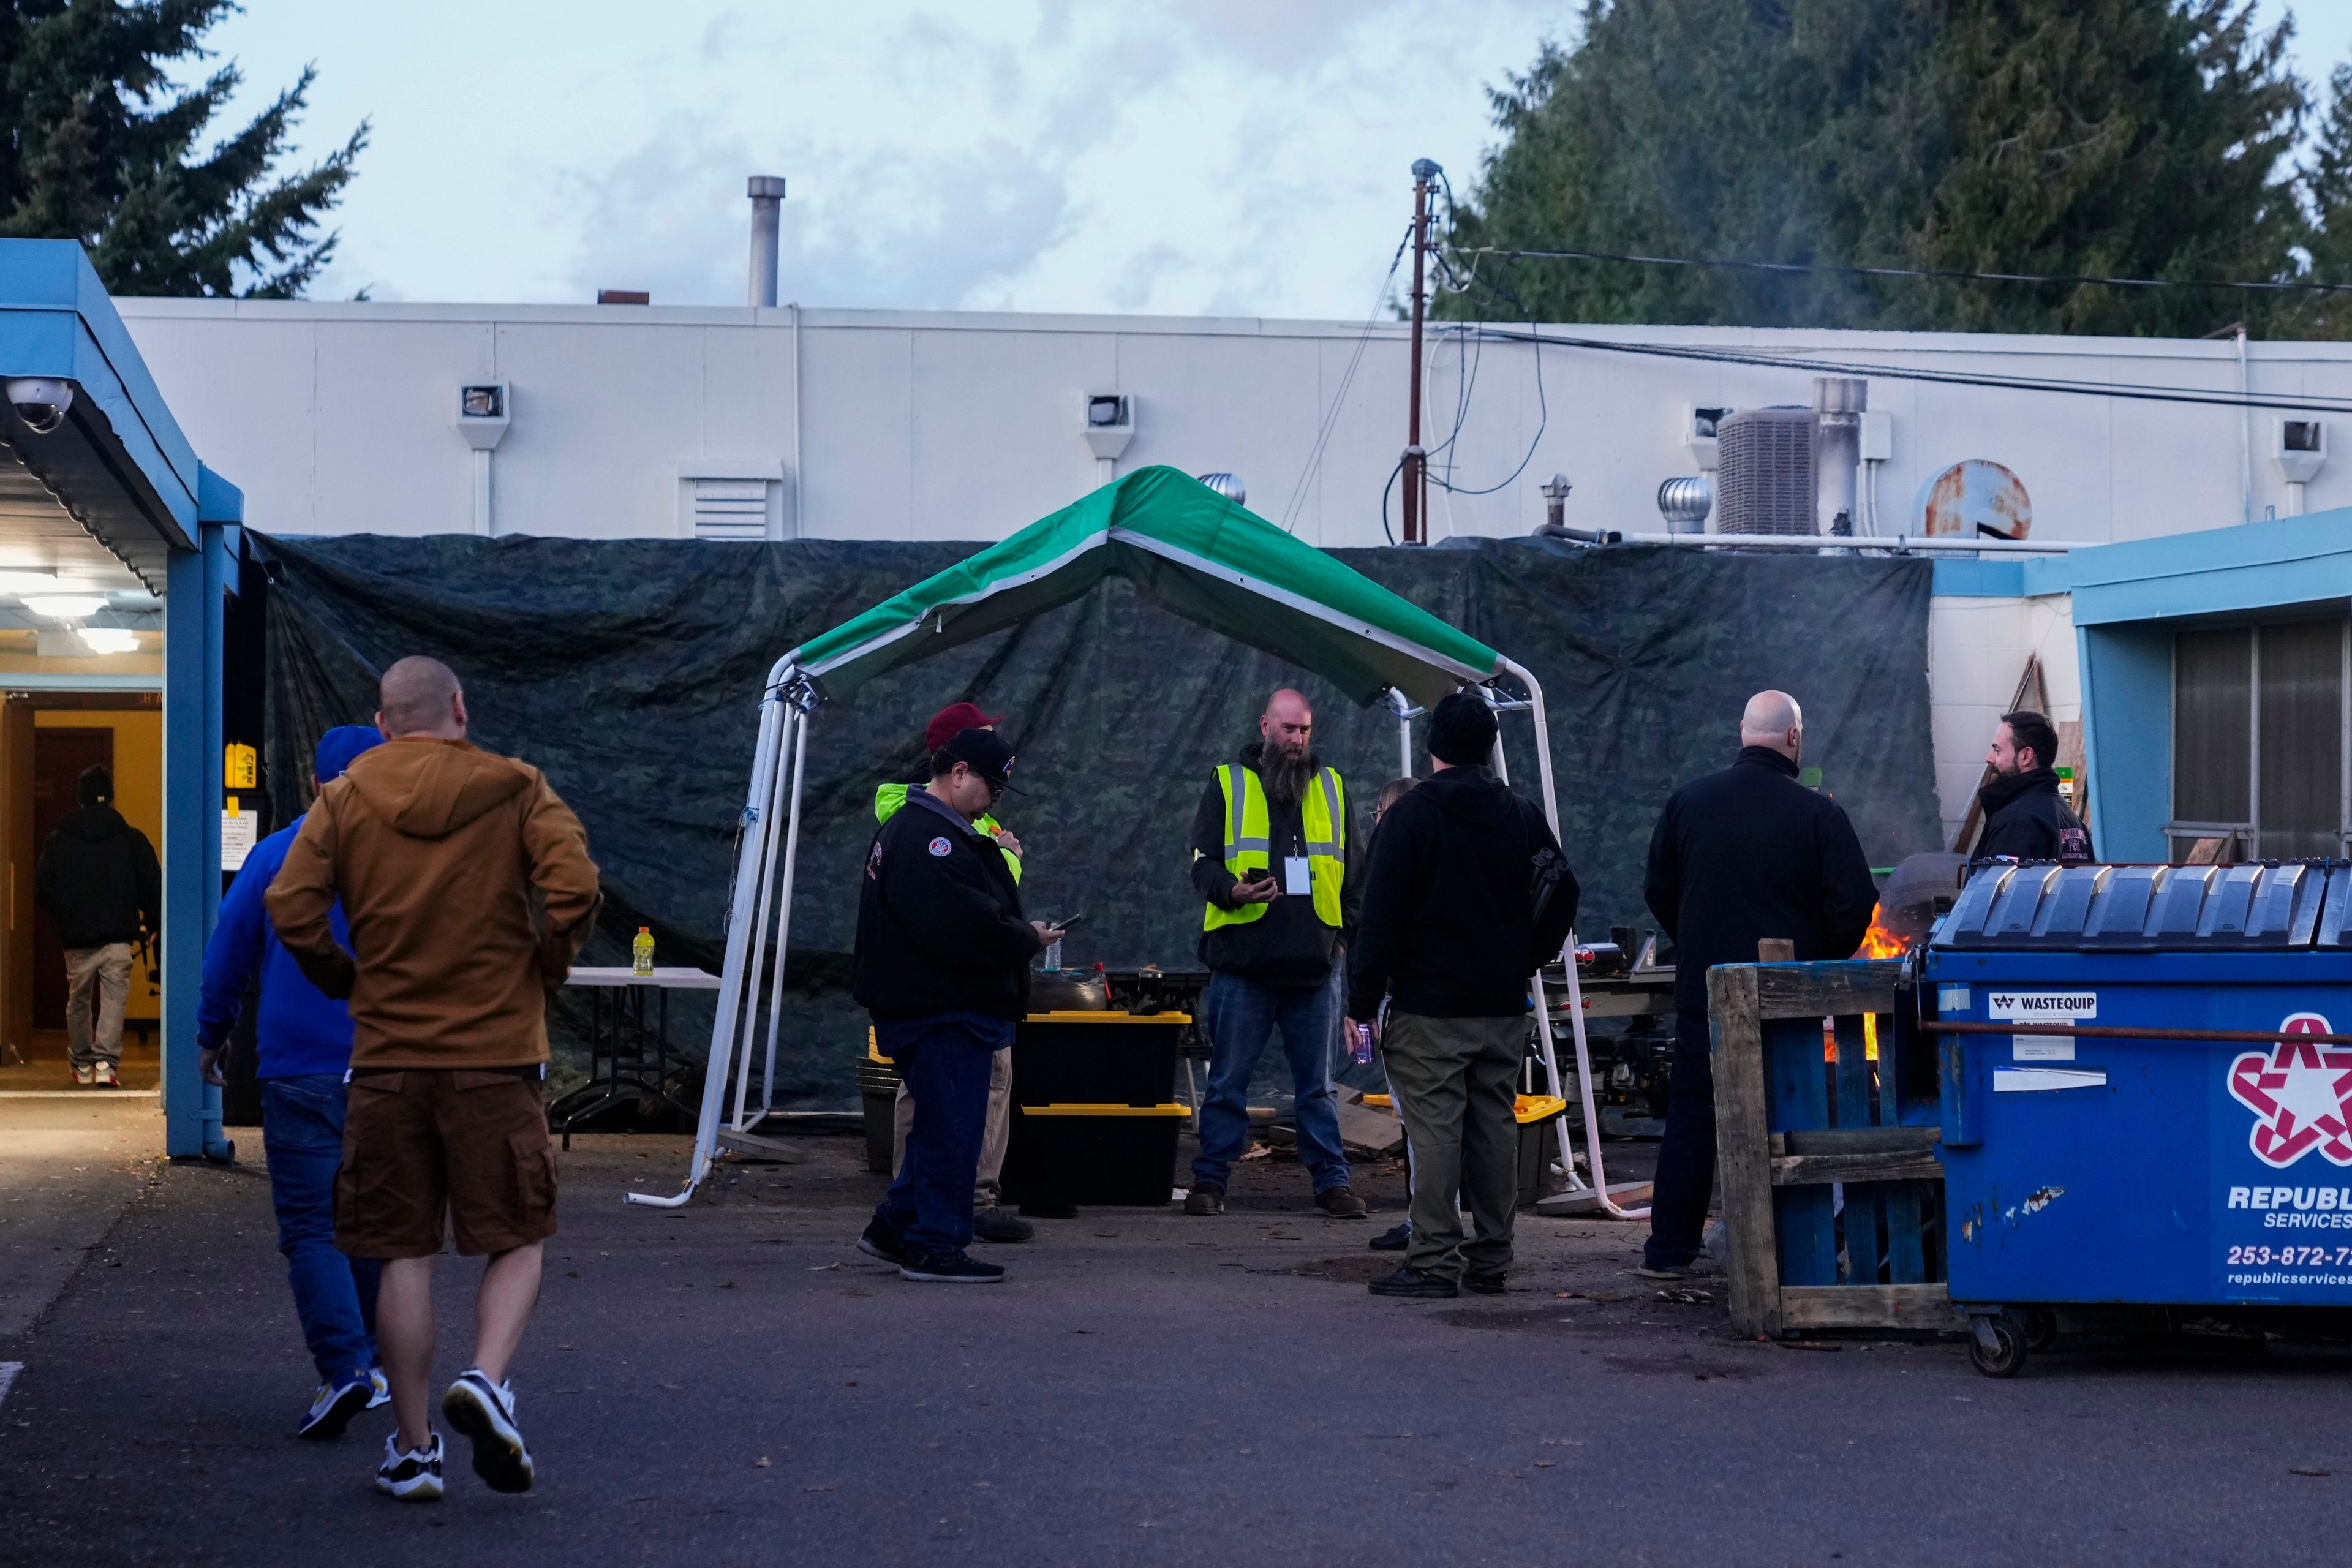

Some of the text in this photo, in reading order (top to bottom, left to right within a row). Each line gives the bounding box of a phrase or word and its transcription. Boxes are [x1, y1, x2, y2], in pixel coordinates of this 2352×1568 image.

[2021, 998, 2095, 1011] WASTEQUIP
[2228, 1186, 2352, 1210] REPUBL
[2264, 1213, 2352, 1229] SERVICES
[2227, 1246, 2352, 1266] 253-872-7
